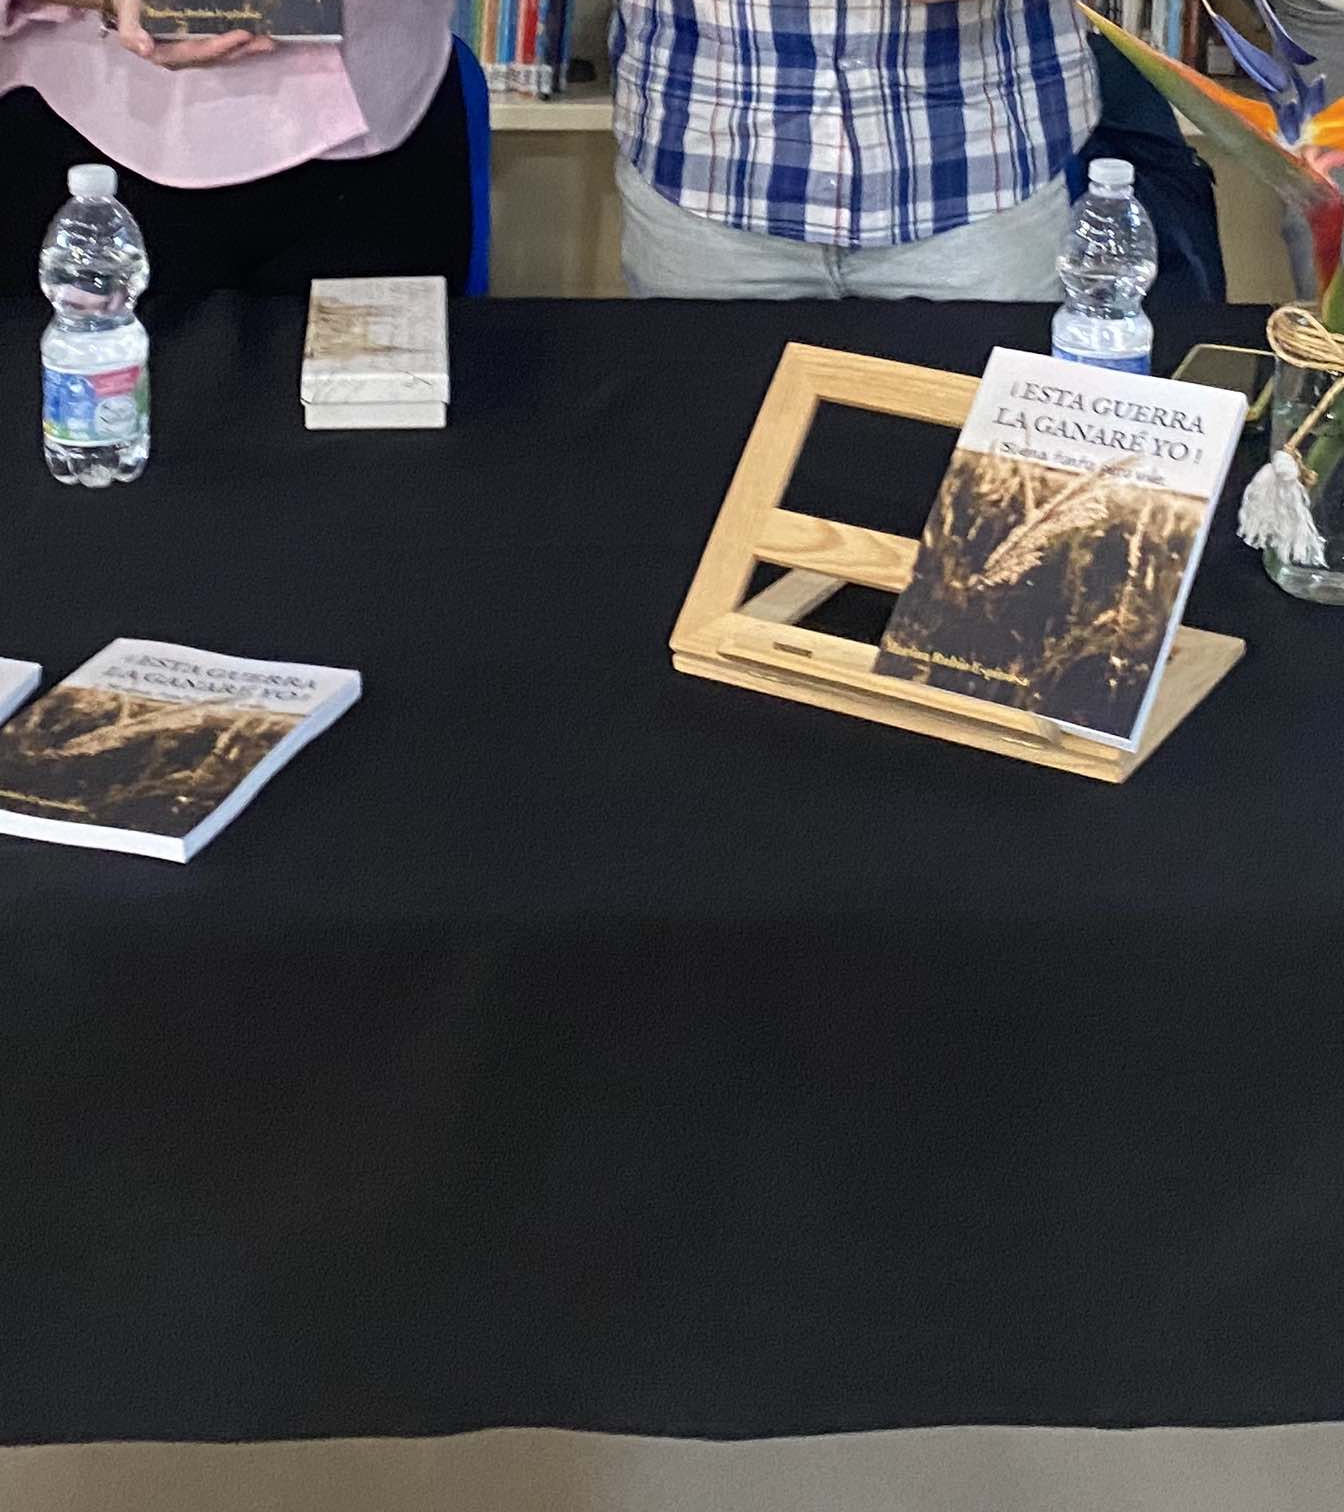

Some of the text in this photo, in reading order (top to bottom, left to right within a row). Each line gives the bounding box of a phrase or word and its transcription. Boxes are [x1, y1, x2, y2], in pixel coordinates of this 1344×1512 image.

[992, 407, 1028, 430] LA
[1033, 414, 1149, 453] GANARÉ
[1091, 396, 1206, 435] GUERRA
[206, 666, 317, 691] GUERRA
